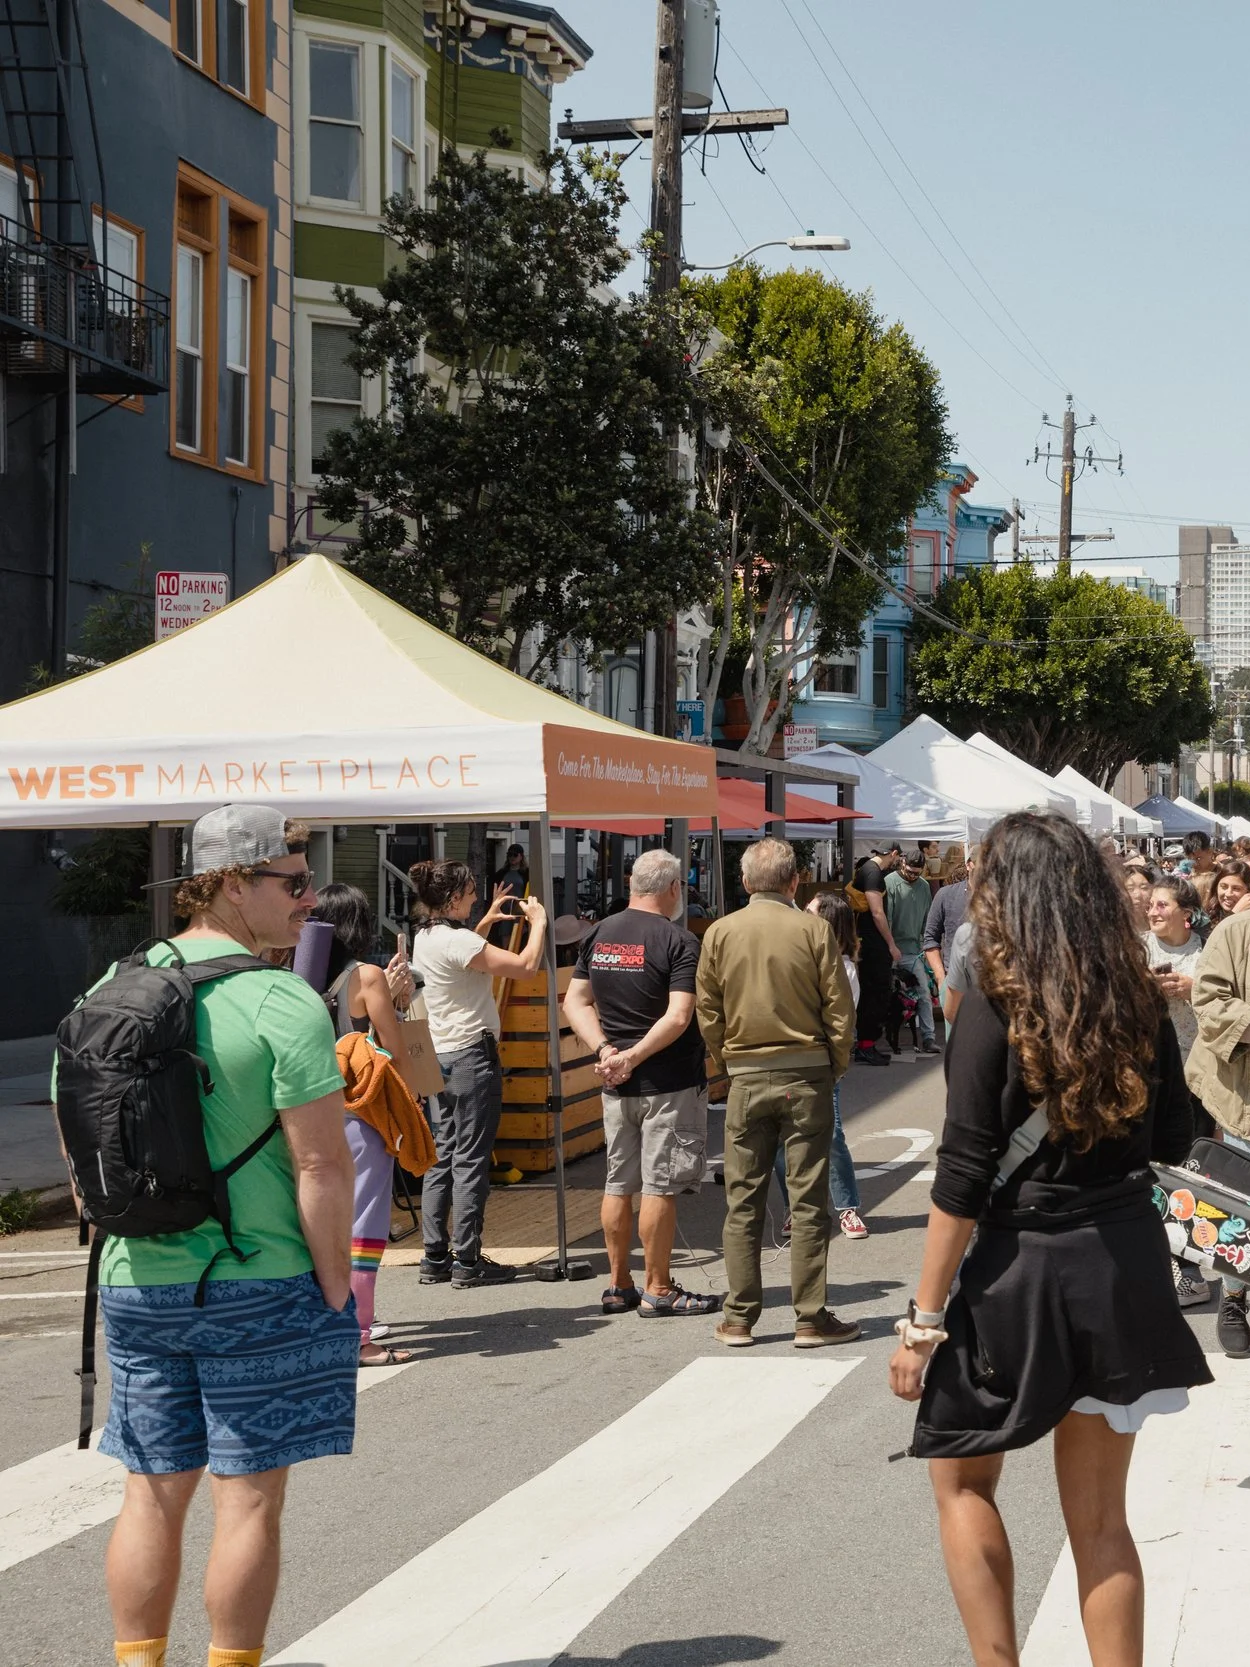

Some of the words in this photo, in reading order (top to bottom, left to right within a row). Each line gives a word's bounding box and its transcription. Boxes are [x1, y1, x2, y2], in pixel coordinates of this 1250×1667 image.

[160, 576, 178, 594] NO
[182, 580, 223, 594] PARKING
[160, 598, 172, 611] 12
[203, 599, 210, 612] 2
[161, 617, 201, 628] WEDNE
[682, 703, 702, 711] HERE
[784, 726, 794, 735] NO
[8, 764, 144, 801] WEST
[157, 754, 479, 795] MARKETPLACE
[558, 752, 579, 777] Come
[579, 755, 592, 779] For
[593, 756, 604, 780] The
[646, 763, 660, 795] Stay
[661, 765, 670, 786] For
[671, 765, 681, 787] The
